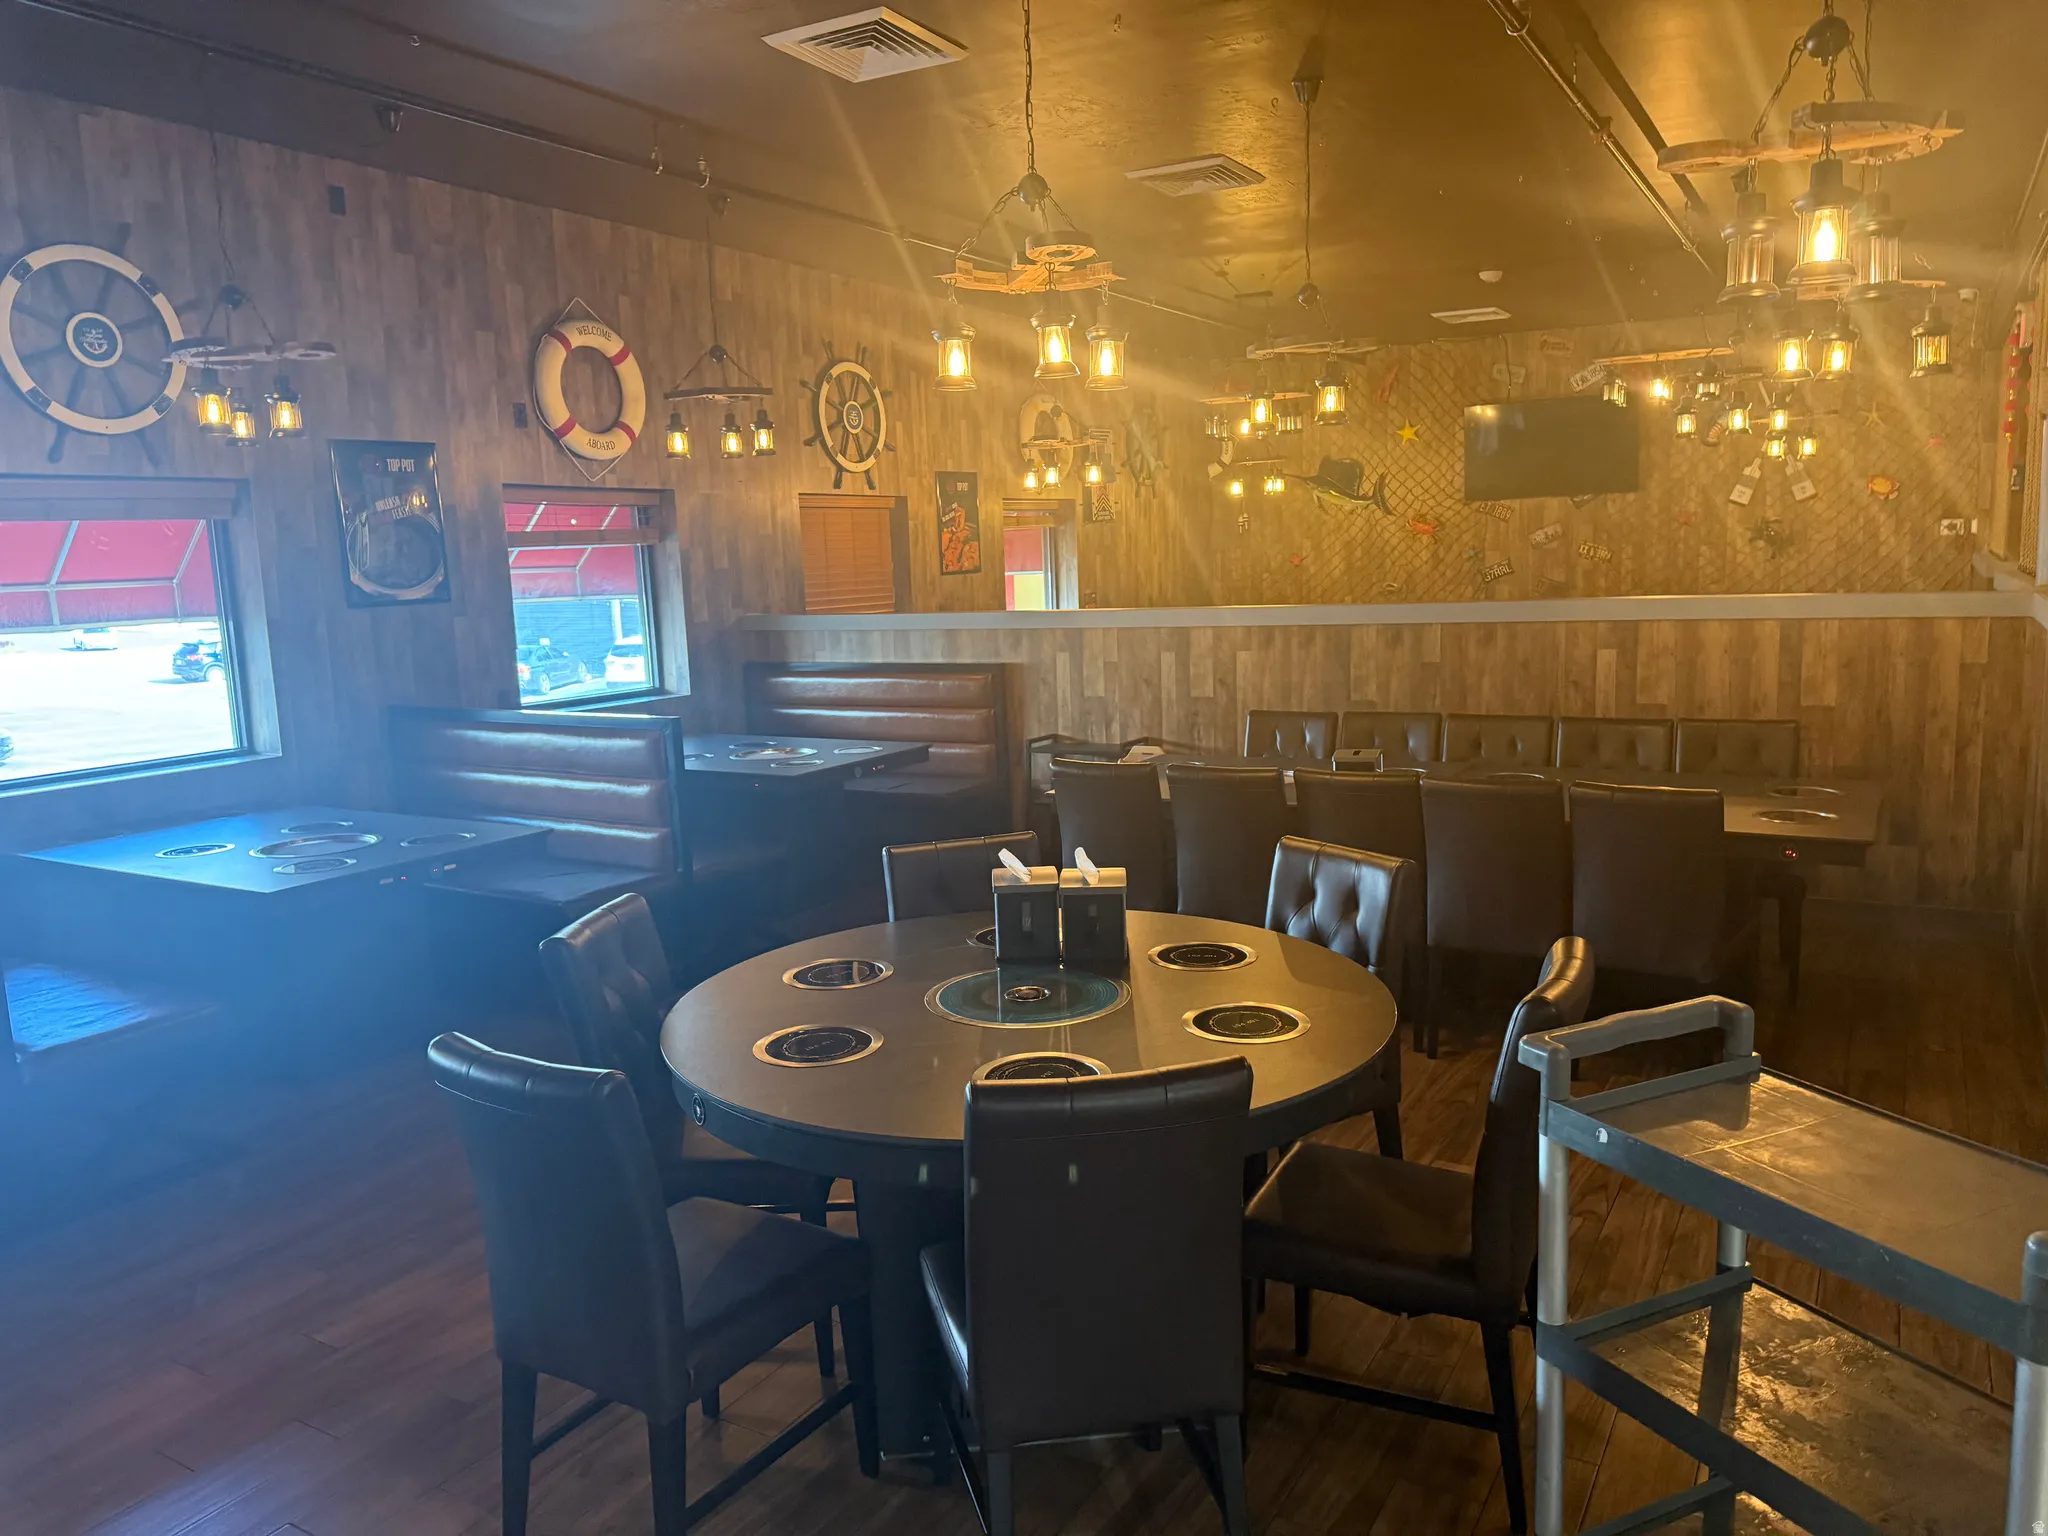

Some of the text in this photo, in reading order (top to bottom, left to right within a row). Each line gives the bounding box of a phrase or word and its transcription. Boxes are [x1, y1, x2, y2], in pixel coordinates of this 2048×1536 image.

[576, 325, 612, 341] WELCOME
[586, 438, 616, 451] ABOARD
[386, 458, 415, 472] TOP POT
